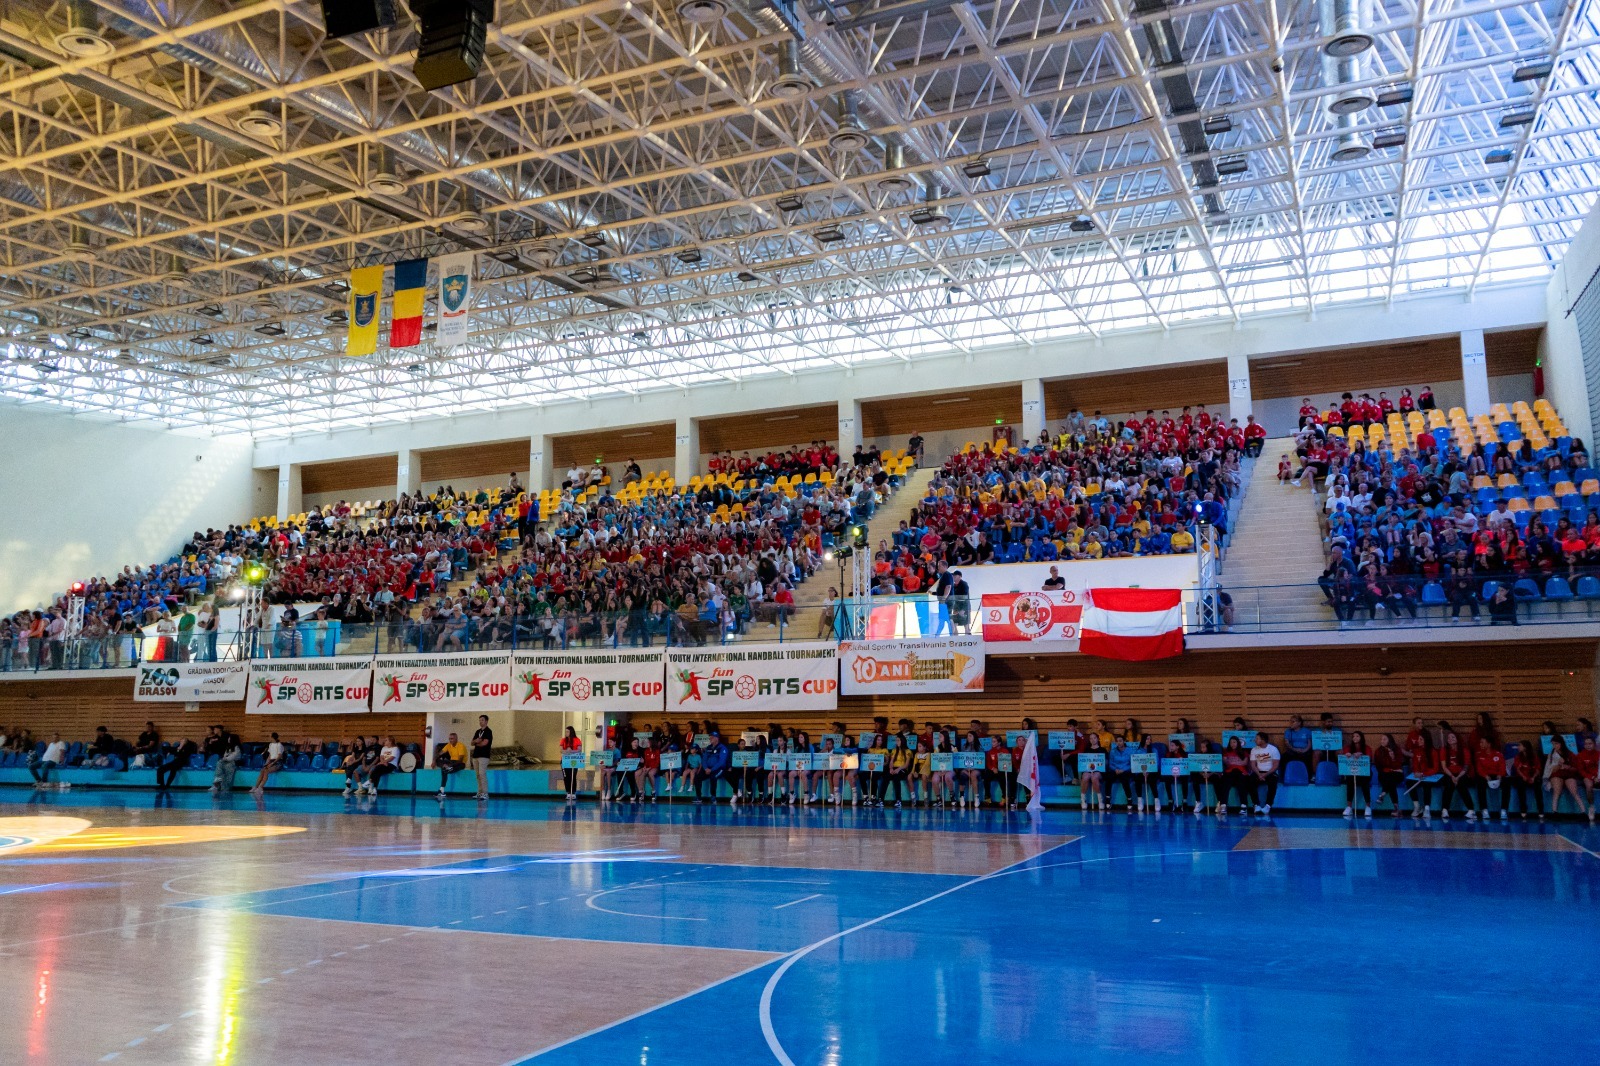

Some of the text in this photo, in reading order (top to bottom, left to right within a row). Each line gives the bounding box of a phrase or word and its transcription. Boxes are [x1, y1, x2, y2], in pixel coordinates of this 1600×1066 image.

[871, 643, 897, 653] Sportiv
[898, 640, 947, 650] Transilvania
[514, 653, 663, 665] YOUTH INTERNATIONAL HANDBALL TOURNAMENT
[668, 648, 836, 663] YOUTH INTERNATIONAL HANDBALL TOURNAMENT
[251, 661, 371, 672] YOUTH INTERNATIONAL HANDBALL TOURNAMENT
[376, 656, 510, 668] YOUTH INTERNATIONAL HANDBALL TOURNAMENT
[551, 669, 572, 679] fun
[710, 667, 734, 679] fun
[853, 657, 909, 682] 10 ANI
[140, 667, 180, 686] ZOO
[281, 676, 298, 685] fun
[410, 672, 428, 682] fun
[481, 683, 509, 696] CUP
[632, 681, 663, 696] CUP
[802, 679, 837, 694] CUP
[345, 687, 370, 700] CUP
[1102, 693, 1109, 701] 8
